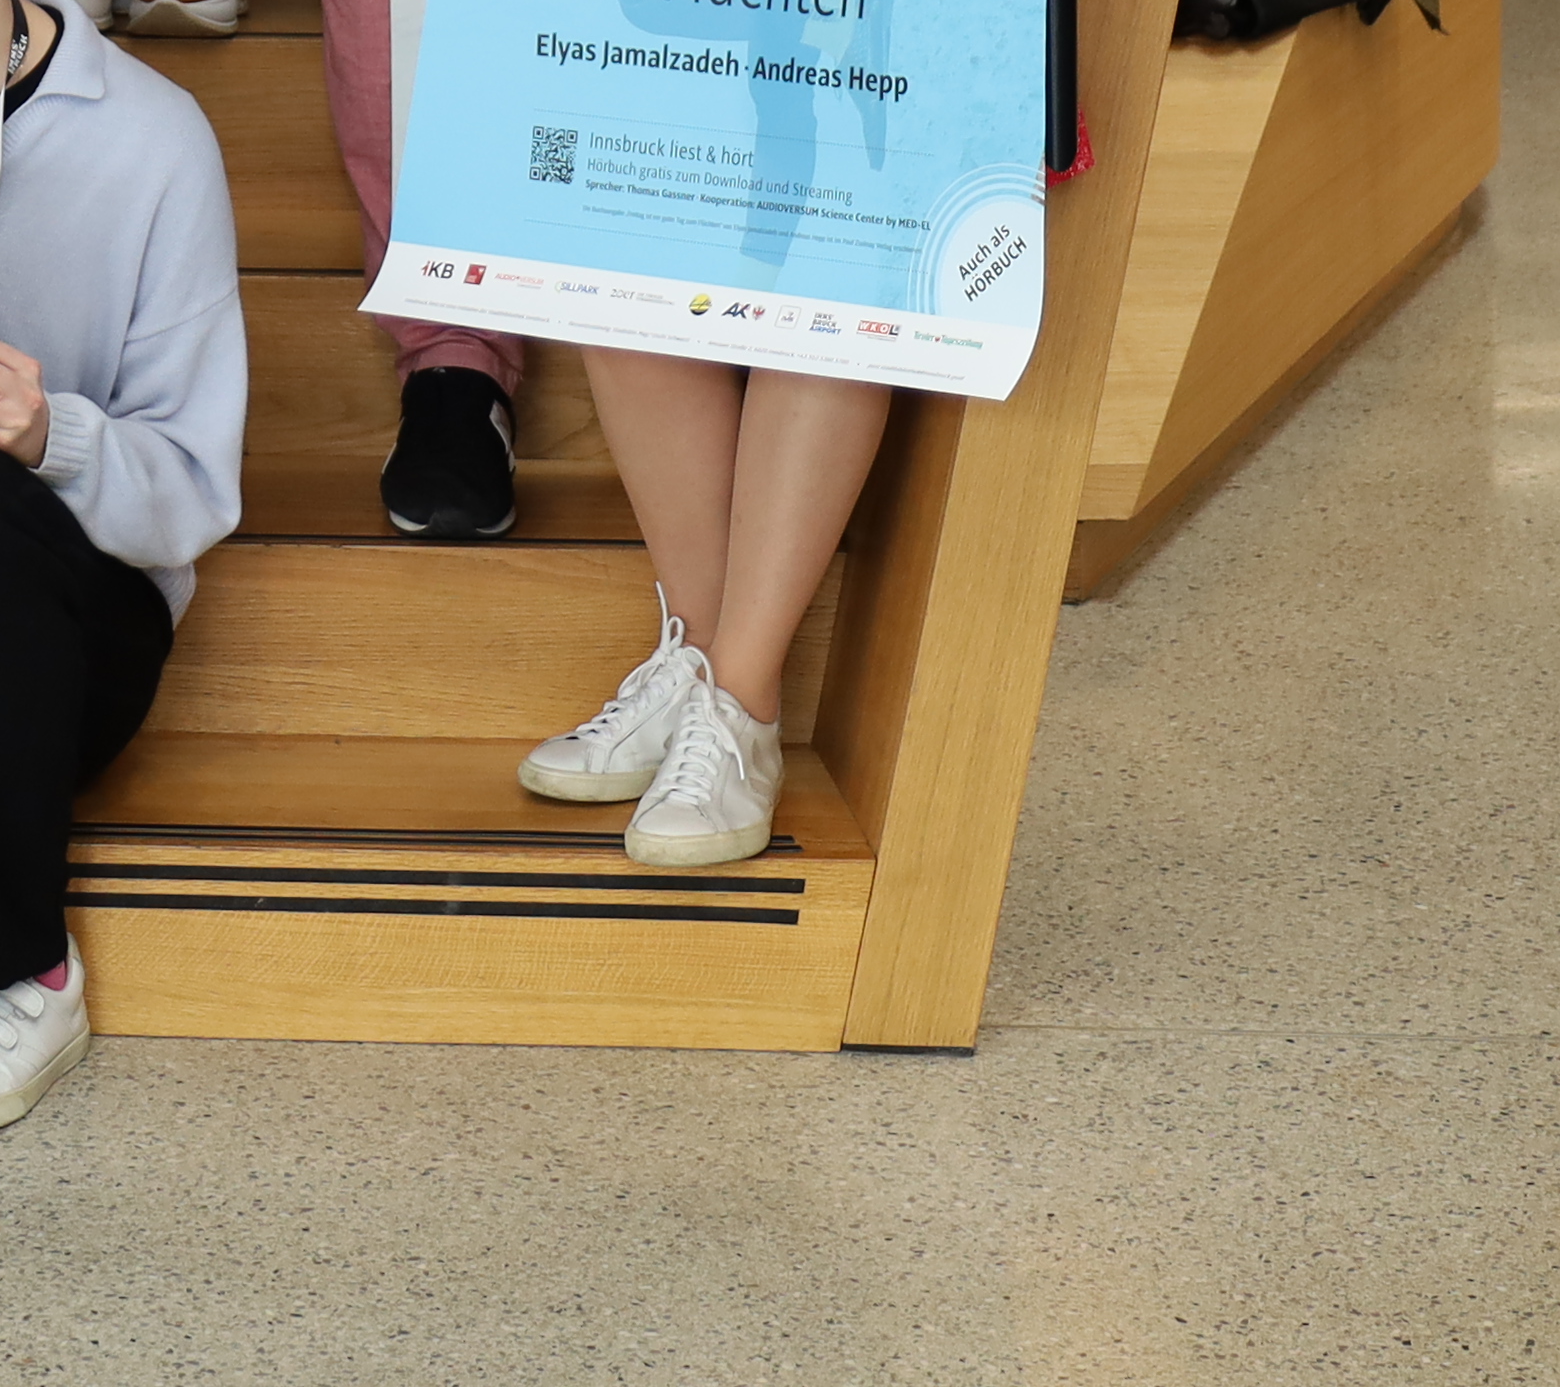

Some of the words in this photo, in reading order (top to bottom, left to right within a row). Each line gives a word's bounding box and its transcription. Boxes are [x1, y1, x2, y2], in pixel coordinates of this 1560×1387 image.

[536, 33, 596, 65] Elyas
[601, 40, 739, 76] Jamalzadeh
[753, 56, 842, 89] Andreas
[849, 66, 908, 102] Hepp
[589, 132, 664, 157] Innsbruck
[670, 139, 701, 161] liest
[706, 145, 716, 164] &
[721, 146, 754, 168] hört
[585, 179, 625, 193] Sprecher:
[627, 184, 660, 197] Thomas
[661, 189, 695, 201] Gassner
[756, 200, 819, 217] AUDIOVERSUM
[821, 208, 854, 222] Science
[855, 213, 884, 225] Center
[885, 216, 897, 229] by
[898, 218, 931, 231] MED-EL
[587, 158, 636, 176] Hörbuch
[639, 166, 672, 181] gratis
[675, 171, 700, 184] zum
[704, 171, 762, 193] Download
[766, 180, 789, 194] und
[792, 182, 853, 206] Streaming
[958, 244, 992, 281] Auch
[990, 225, 1010, 247] als
[964, 236, 1027, 301] HÖRBUCH
